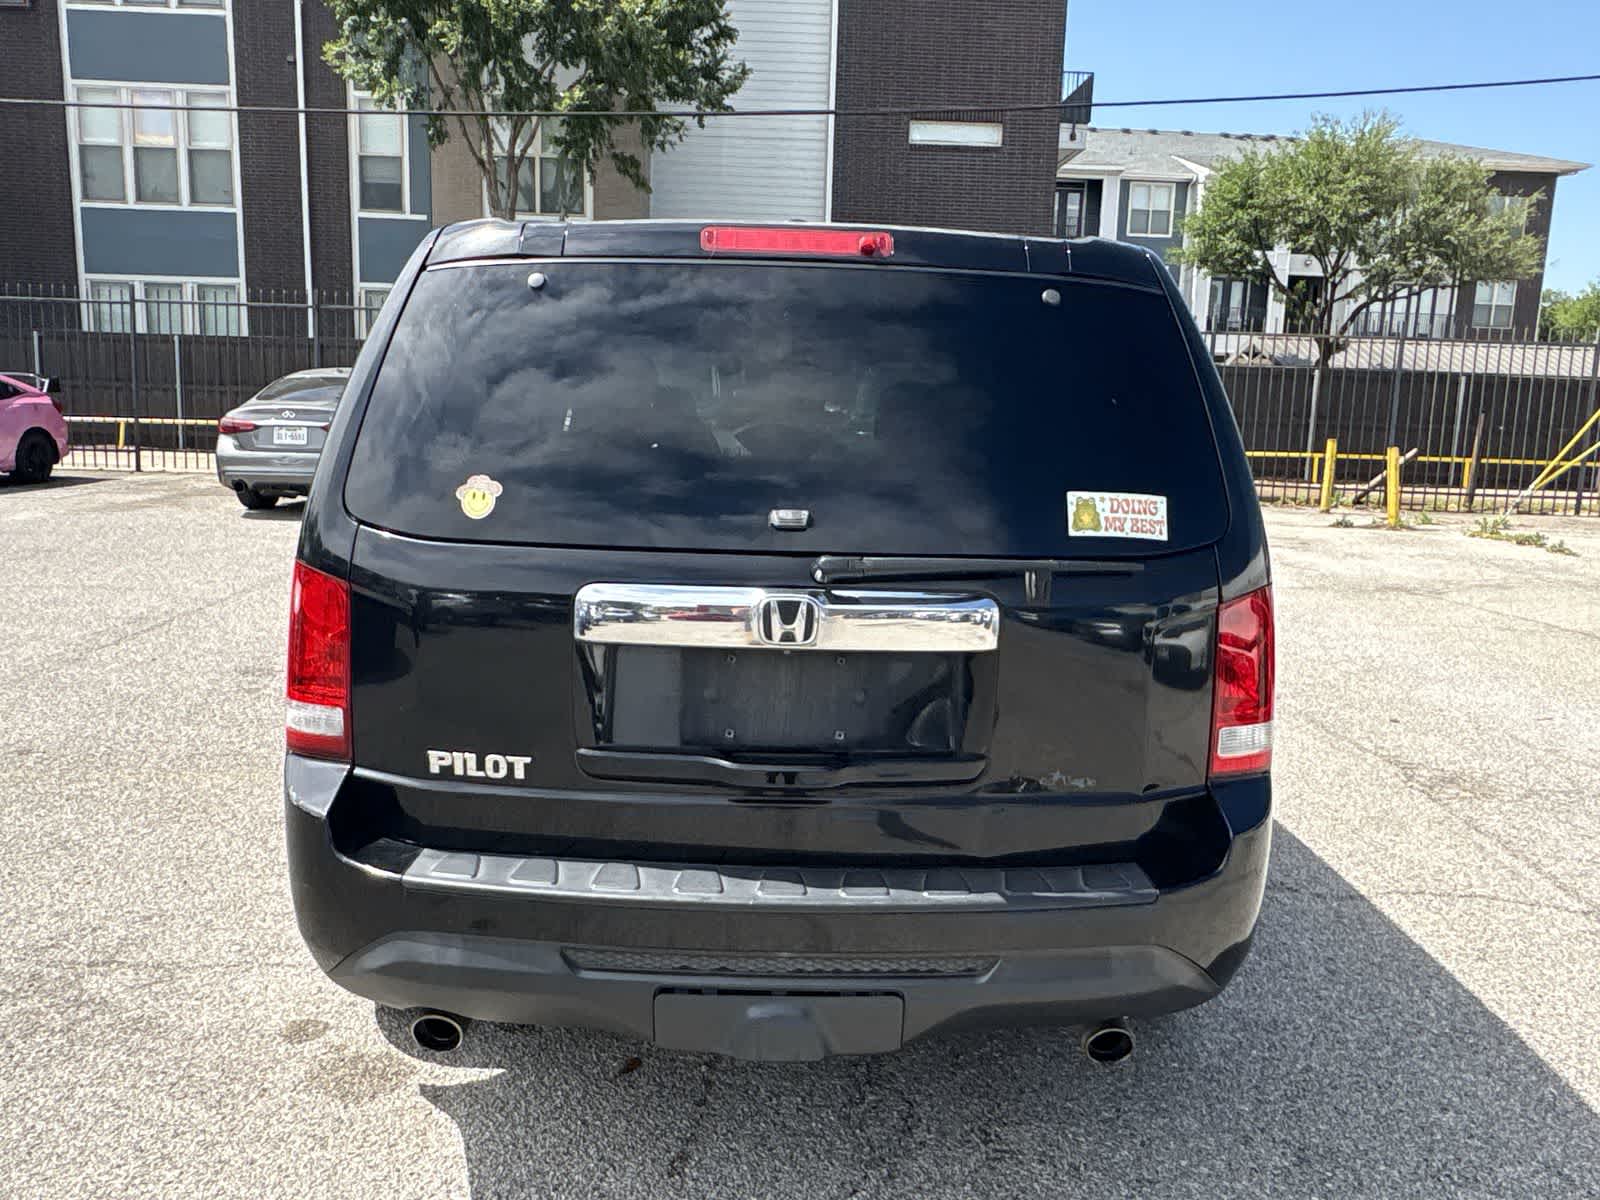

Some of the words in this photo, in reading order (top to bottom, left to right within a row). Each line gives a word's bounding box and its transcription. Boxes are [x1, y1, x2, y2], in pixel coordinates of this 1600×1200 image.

[1108, 496, 1159, 516] DOING
[1103, 515, 1128, 533] MY
[1130, 517, 1166, 536] BEST
[426, 749, 533, 780] PILOT
